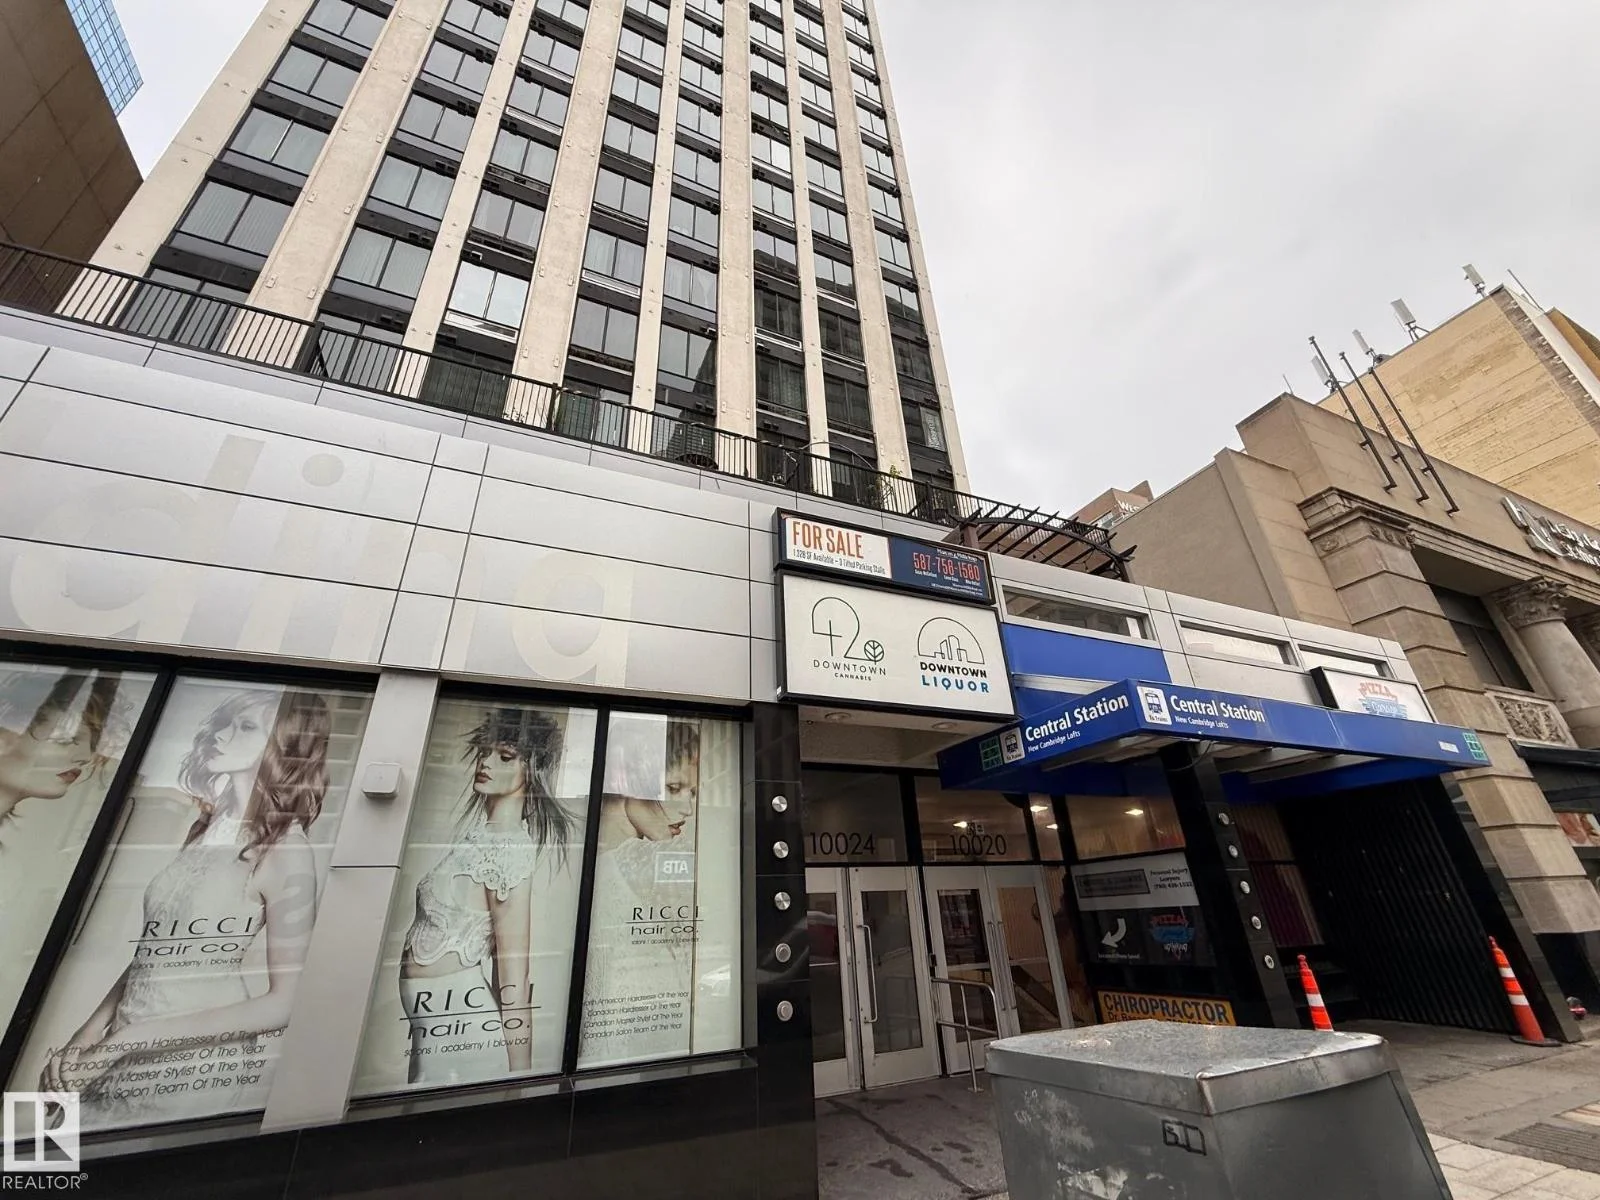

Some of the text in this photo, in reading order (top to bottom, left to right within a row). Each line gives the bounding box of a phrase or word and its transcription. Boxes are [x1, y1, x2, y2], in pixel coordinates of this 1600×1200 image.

[792, 521, 864, 559] FOR SALE
[813, 659, 887, 676] DOWNTOWN
[834, 672, 872, 682] CANNABIS
[919, 661, 987, 678] DOWNTOWN
[921, 675, 990, 693] LIQUOR
[1357, 682, 1395, 698] PIZZA
[1025, 694, 1129, 742] Central Station
[1170, 694, 1266, 723] Central Station
[1188, 716, 1215, 729] Cambridge
[1215, 720, 1229, 729] Lofts
[1027, 730, 1081, 753] New Cambridge Lofts
[809, 832, 876, 856] 10024
[949, 834, 1007, 856] 10020
[631, 905, 699, 921] RICCI
[141, 916, 253, 938] RICCI
[631, 924, 699, 936] hair co.
[134, 942, 246, 957] hair co.
[163, 959, 202, 968] academy
[413, 983, 535, 1014] RICCI
[1103, 992, 1229, 1024] CHIROPRACTOR
[407, 1017, 530, 1040] hair co.
[84, 1039, 148, 1056] American
[151, 1034, 217, 1048] Hairdresser
[219, 1031, 234, 1042] Of
[238, 1030, 258, 1041] The
[259, 1028, 287, 1038] Year
[440, 1041, 484, 1054] academy
[493, 1037, 513, 1048] blow
[514, 1036, 529, 1046] bar
[128, 1050, 196, 1066] Hairdresser
[199, 1047, 214, 1059] Of
[217, 1046, 237, 1057] The
[242, 1044, 266, 1054] Year
[118, 1070, 161, 1082] Master
[163, 1065, 197, 1079] Stylist
[199, 1062, 215, 1074] Of
[218, 1061, 238, 1072] The
[242, 1058, 268, 1070] Year
[113, 1086, 149, 1100] Salon
[153, 1082, 189, 1096] Team
[192, 1079, 207, 1091] Of
[211, 1076, 232, 1088] The
[236, 1074, 262, 1085] Year
